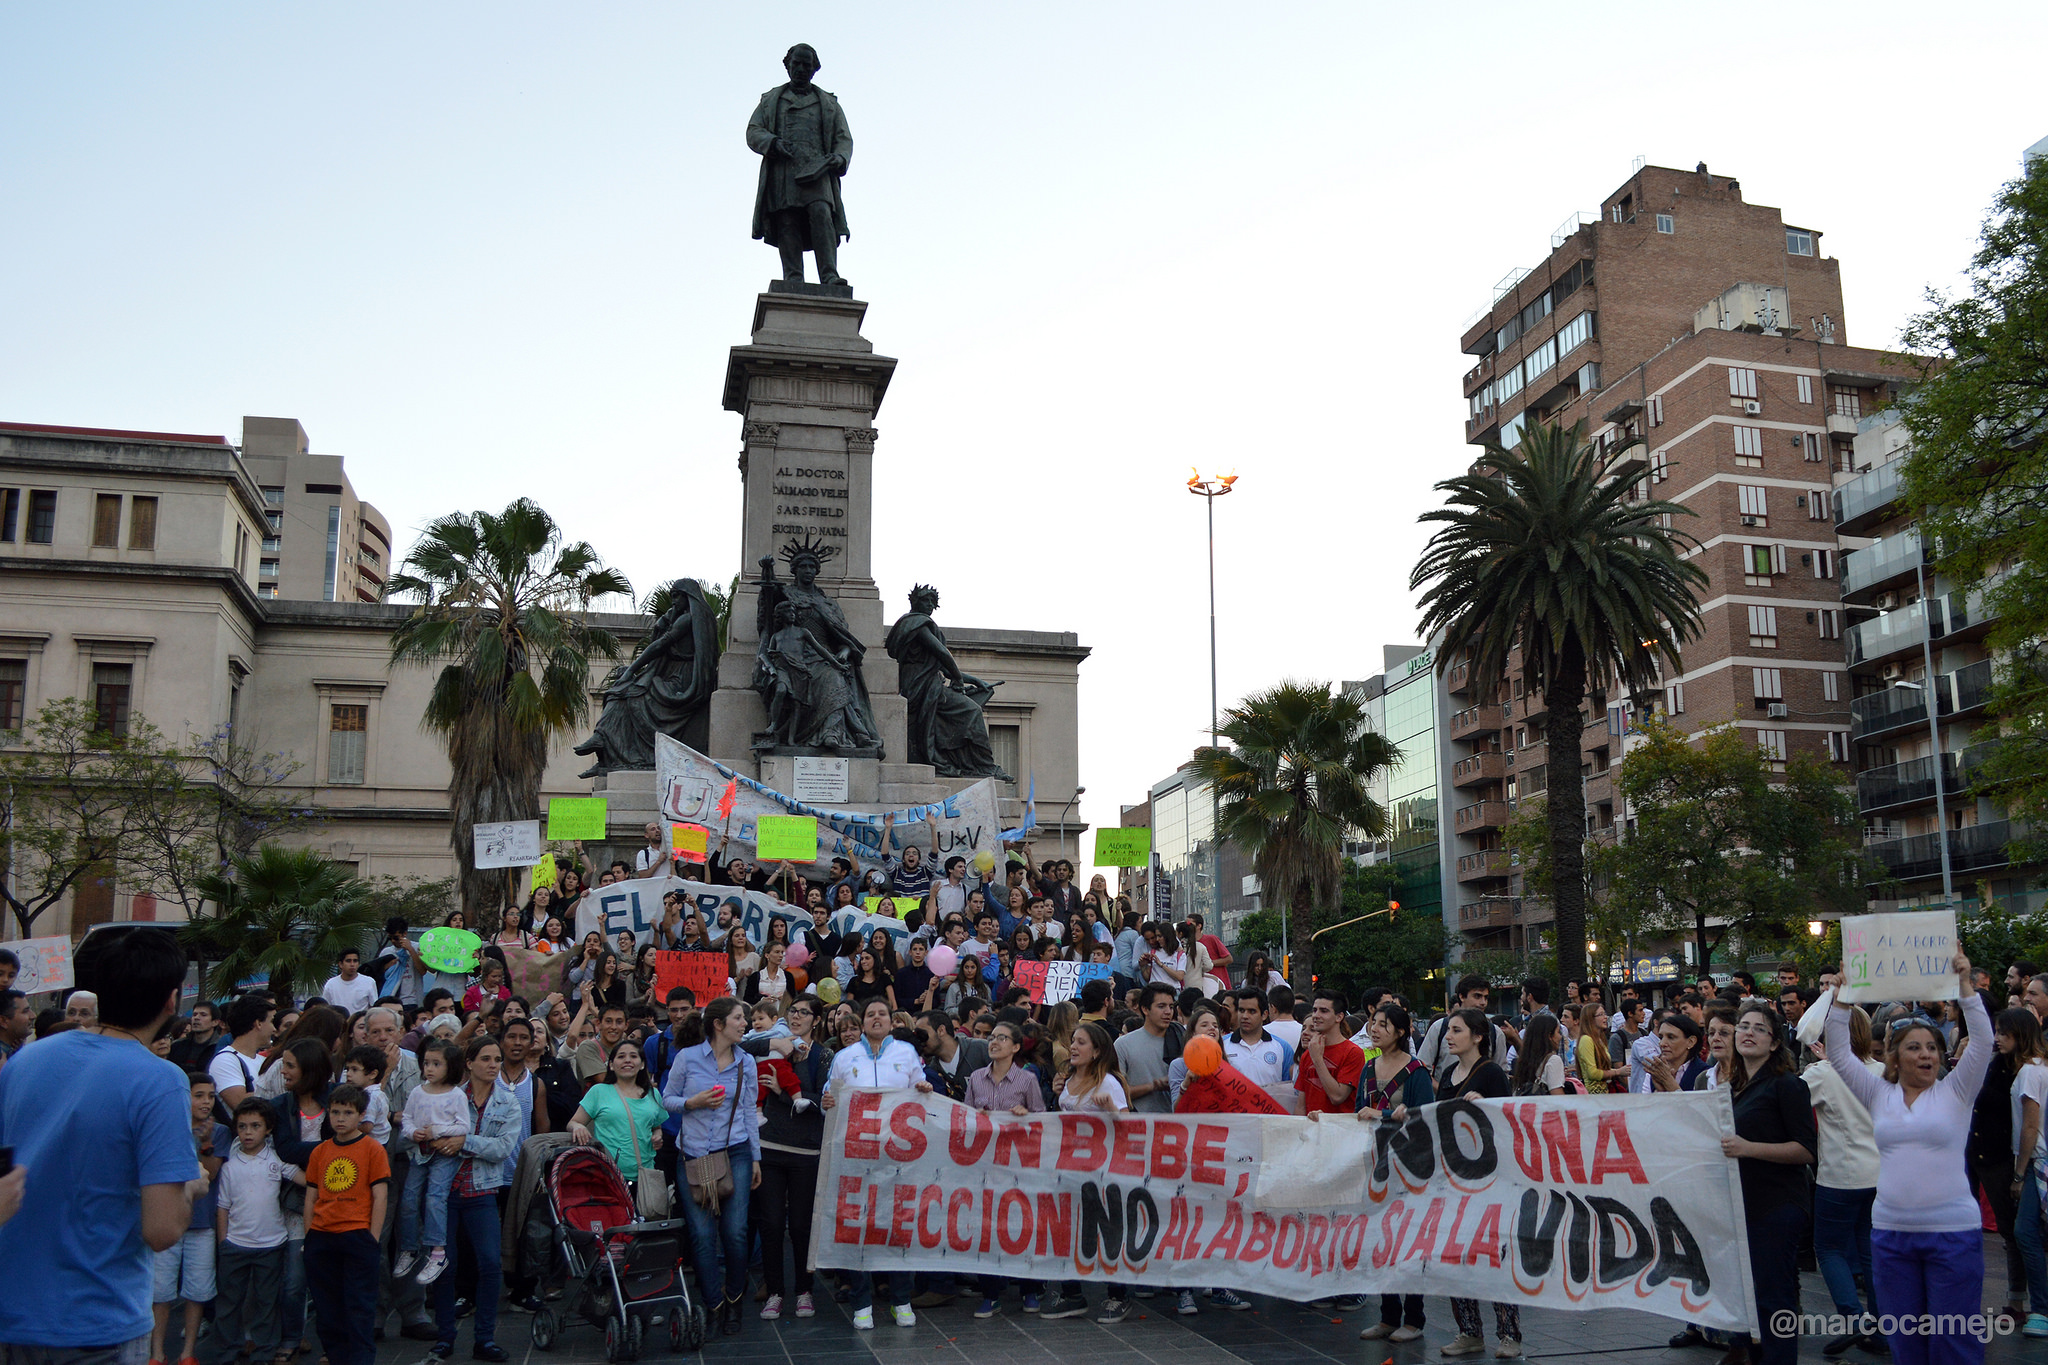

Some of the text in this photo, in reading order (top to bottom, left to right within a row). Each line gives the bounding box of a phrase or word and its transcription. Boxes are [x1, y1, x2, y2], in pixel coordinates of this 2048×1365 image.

[776, 467, 845, 480] AL DOCTOR
[773, 486, 819, 497] DALMACIO
[776, 505, 844, 518] SARSFIELD
[819, 527, 848, 538] NATAL
[672, 783, 709, 818] U
[758, 817, 767, 825] EN
[600, 892, 653, 936] EL
[1848, 929, 1867, 949] NO
[1904, 935, 1949, 949] ABORTO
[40, 945, 67, 955] POR LA
[46, 955, 66, 964] VIDA
[1893, 957, 1908, 977] LA
[1226, 1078, 1247, 1096] NO
[844, 1091, 1649, 1198] ES UN BEBE, NO UNA
[834, 1175, 1713, 1302] ELECCION NO AL ABORTO SI A LA VIDA
